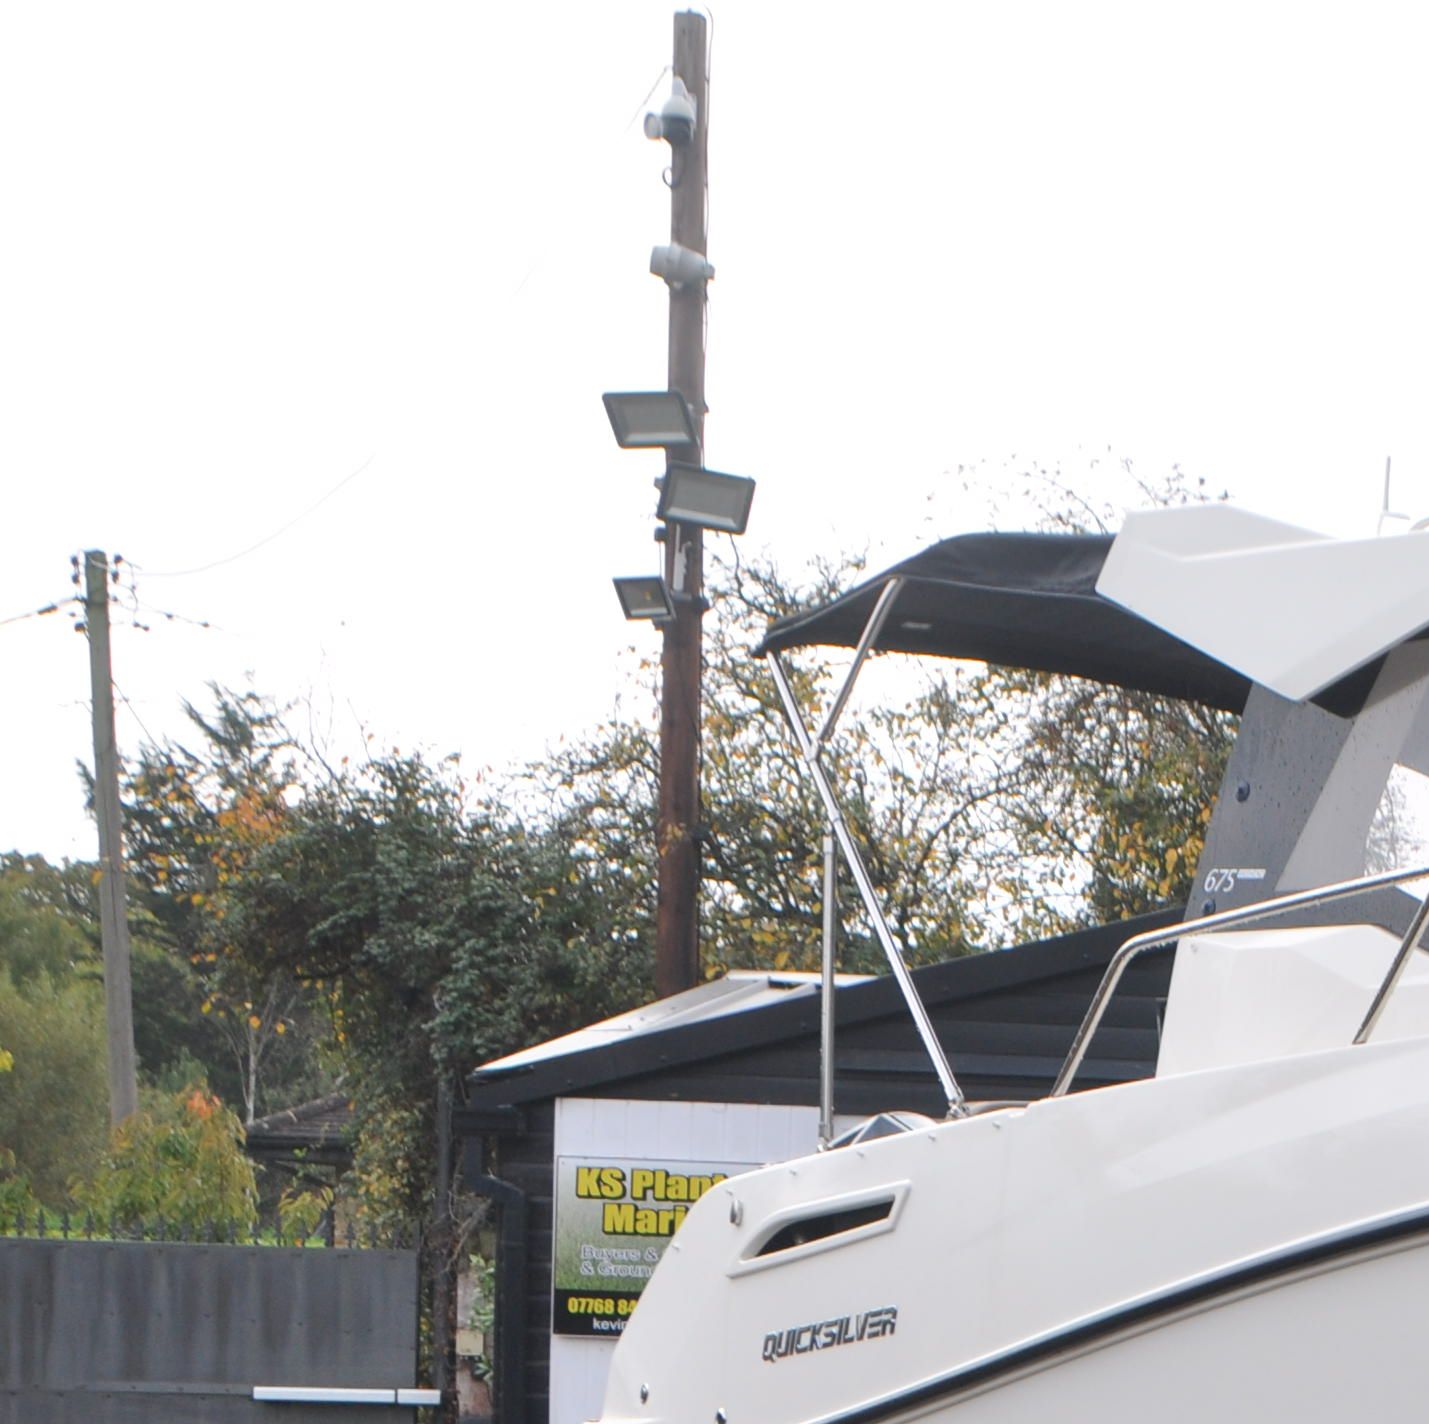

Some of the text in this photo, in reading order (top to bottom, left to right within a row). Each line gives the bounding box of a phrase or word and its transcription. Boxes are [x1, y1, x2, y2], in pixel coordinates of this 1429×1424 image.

[1204, 868, 1238, 893] 675
[576, 1166, 626, 1199] KS
[580, 1244, 659, 1263] Buyers &
[568, 1297, 615, 1316] 07768
[762, 1304, 898, 1363] QUICKSILVER
